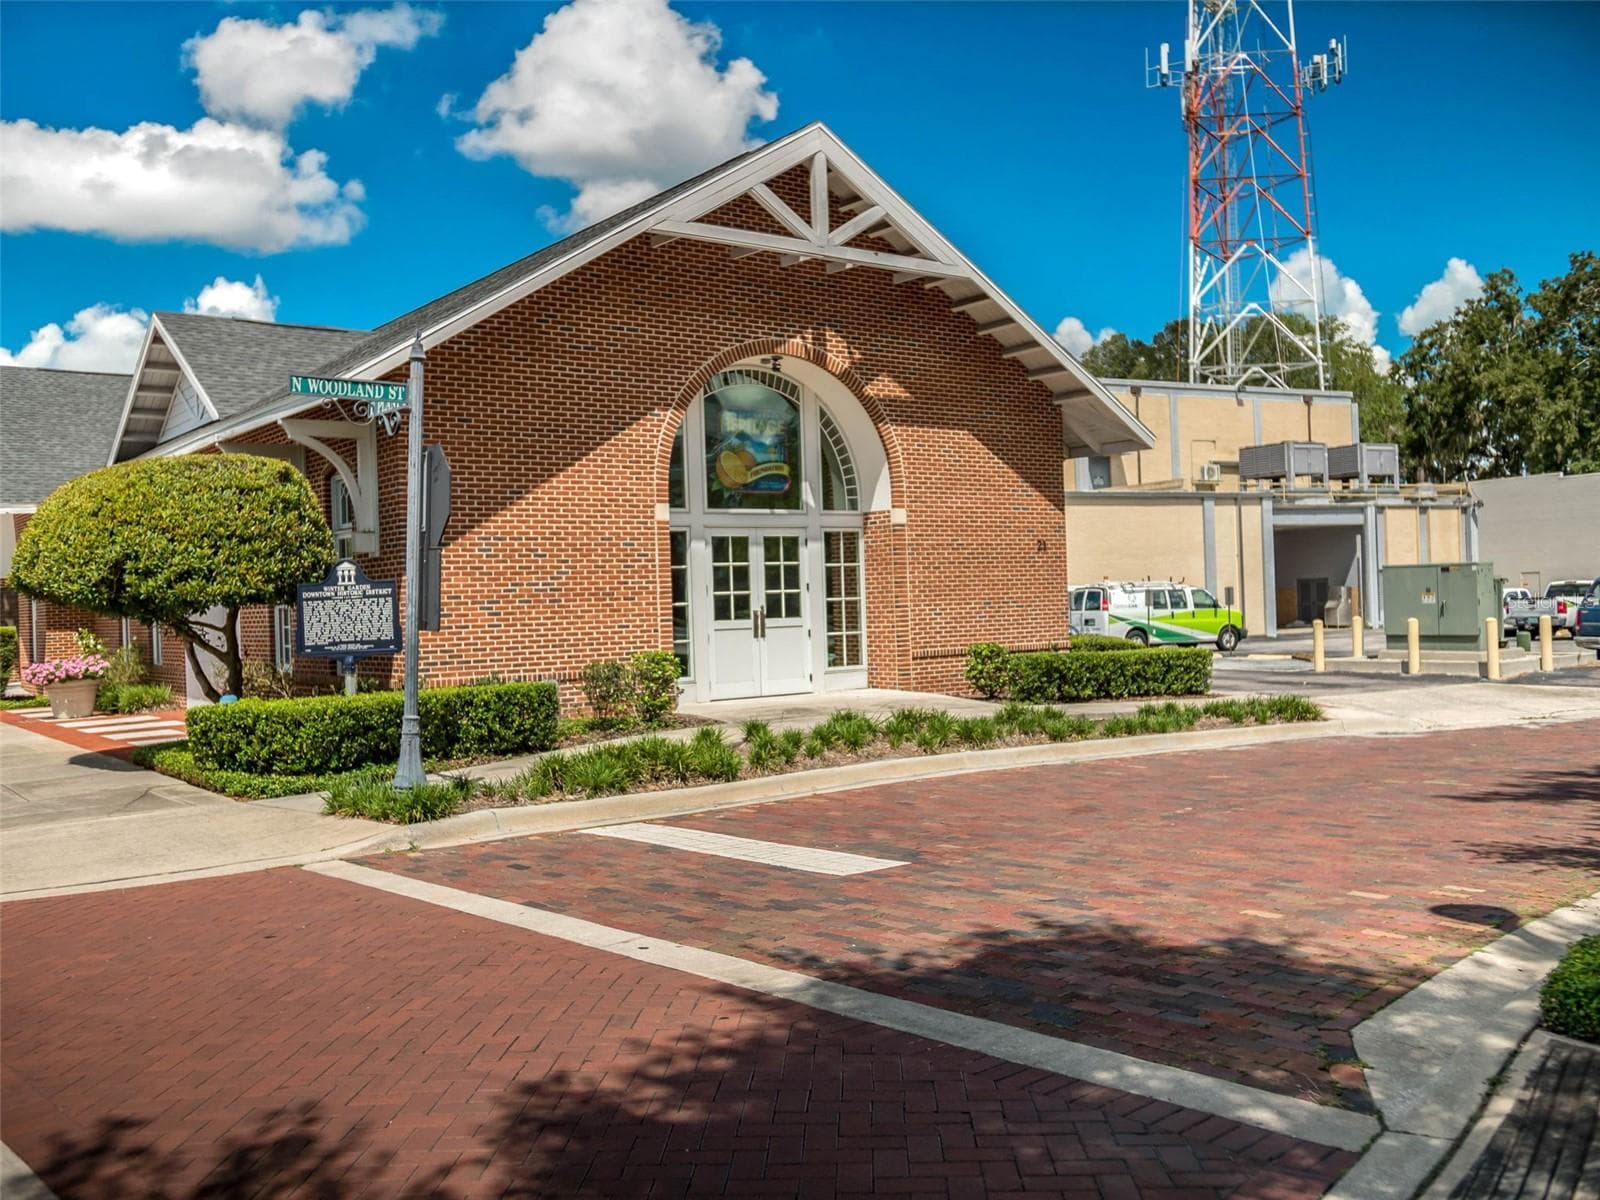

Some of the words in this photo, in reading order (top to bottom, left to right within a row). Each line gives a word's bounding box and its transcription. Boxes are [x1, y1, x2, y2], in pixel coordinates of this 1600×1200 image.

[291, 376, 302, 392] N
[308, 378, 384, 398] WOODLAND
[388, 385, 405, 400] ST
